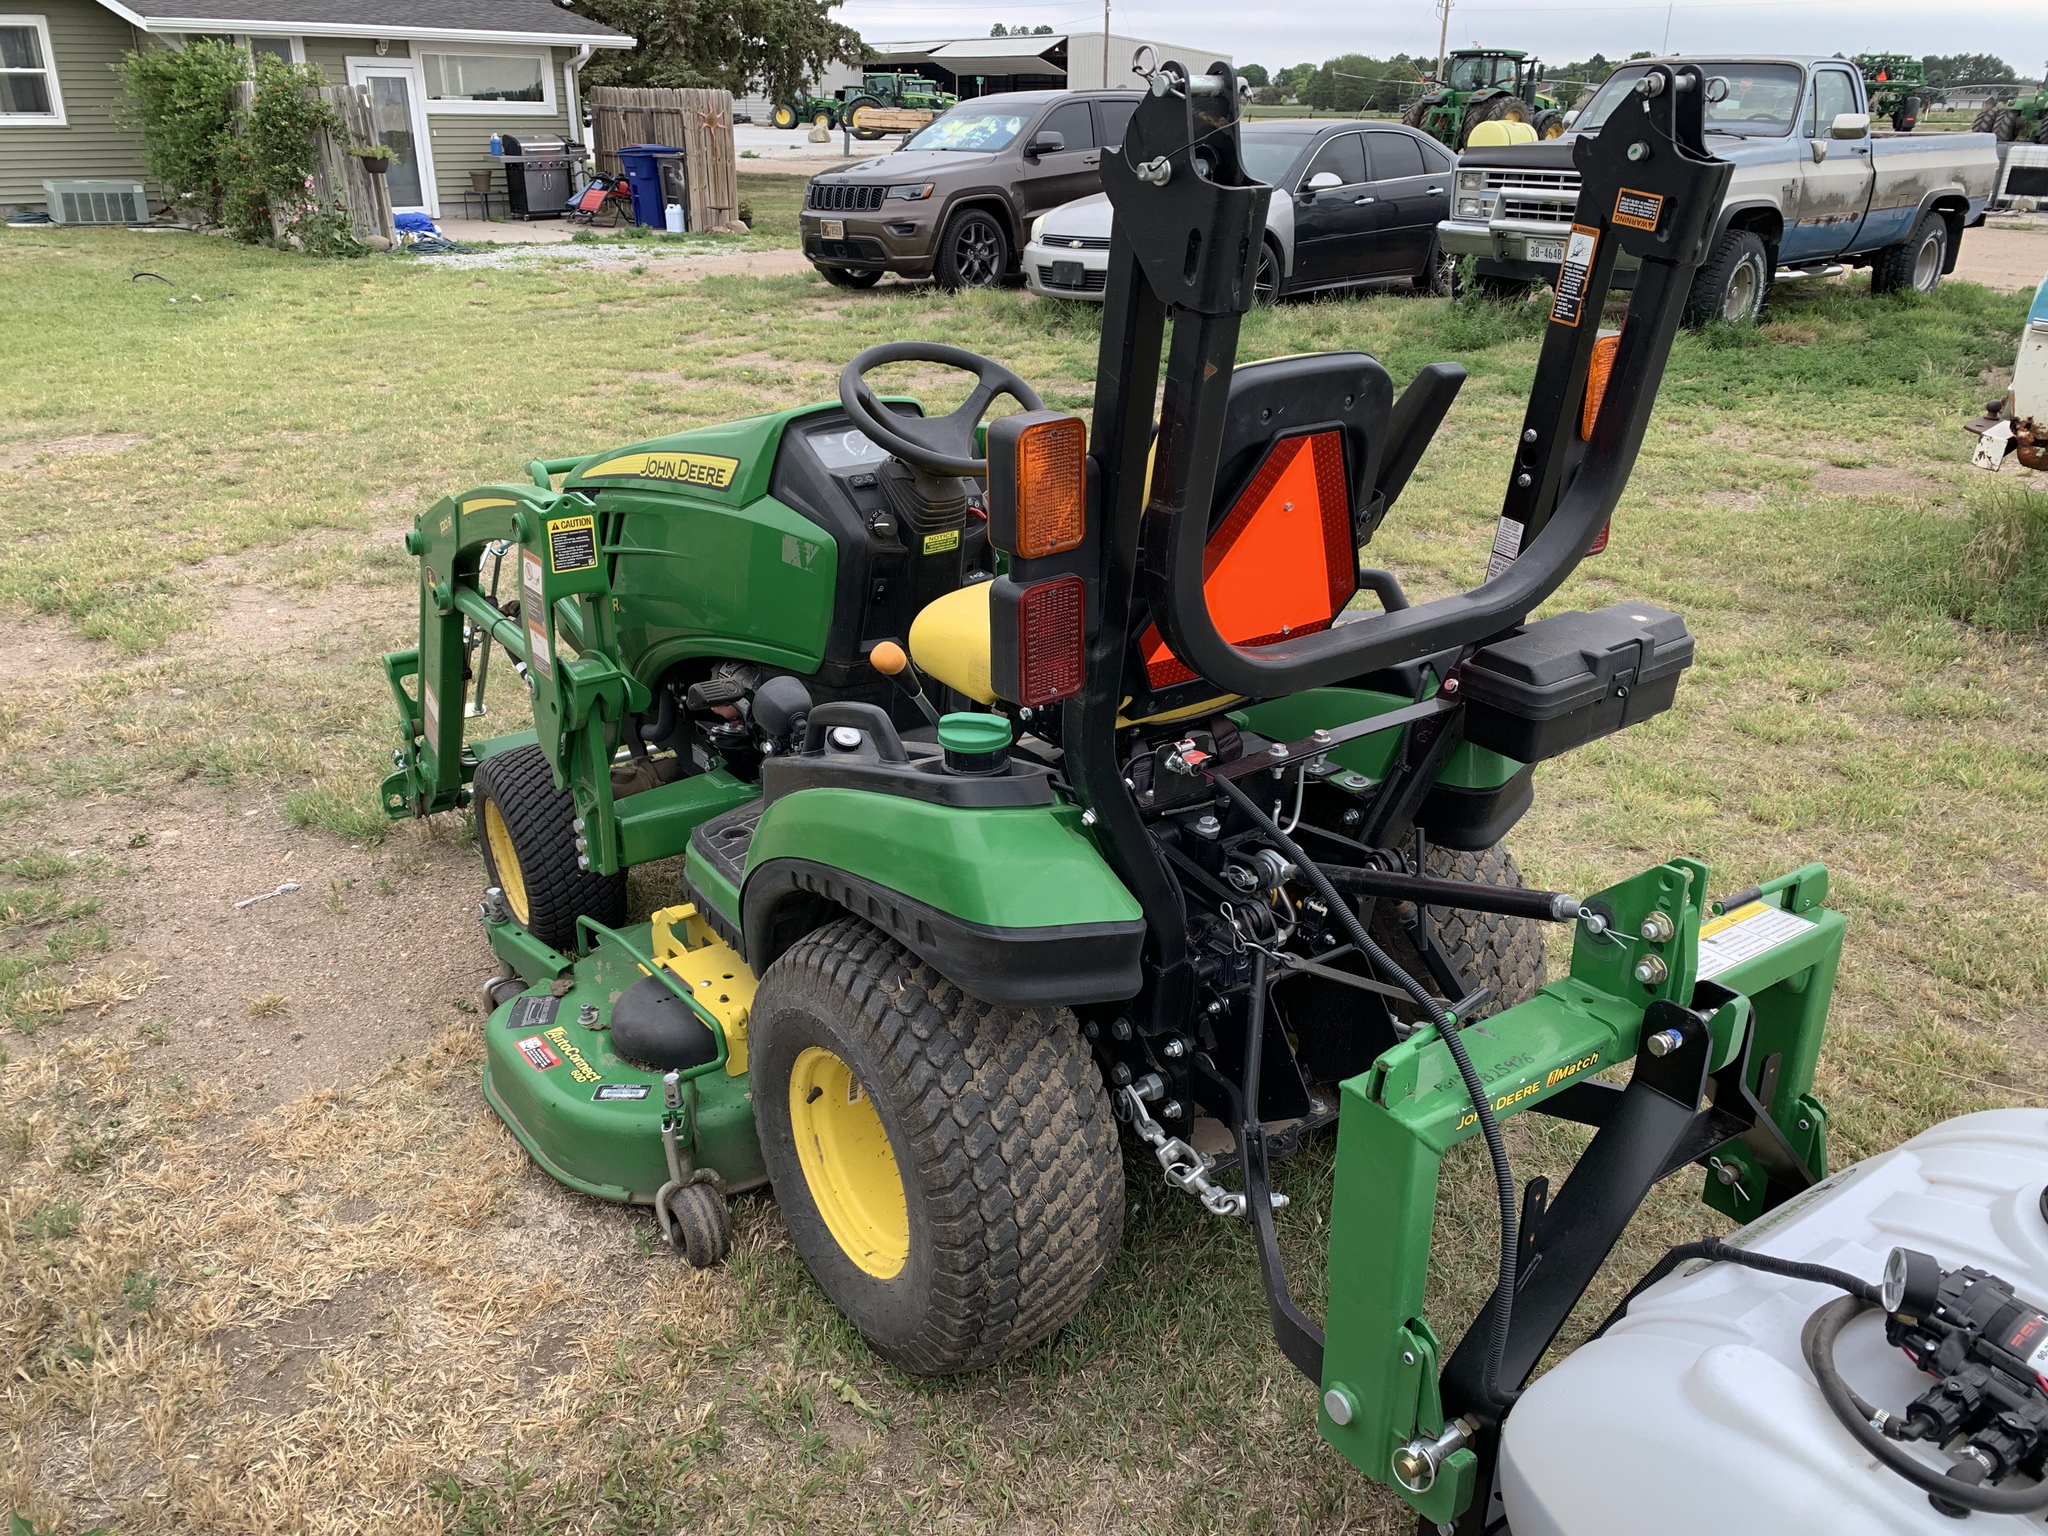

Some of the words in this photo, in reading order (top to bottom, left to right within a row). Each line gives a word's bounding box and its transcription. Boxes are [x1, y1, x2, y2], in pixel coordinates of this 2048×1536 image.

[1614, 214, 1648, 229] WARNING
[1530, 246, 1562, 260] 38-464B
[640, 456, 677, 477] JOHN
[677, 458, 727, 485] DEERE
[560, 517, 592, 530] CAUTION
[928, 531, 955, 542] NOTICE
[545, 1028, 603, 1083] AutoConnect
[570, 1069, 588, 1083] 60D
[1495, 1080, 1542, 1112] DEERE
[1546, 1051, 1600, 1088] iMatch
